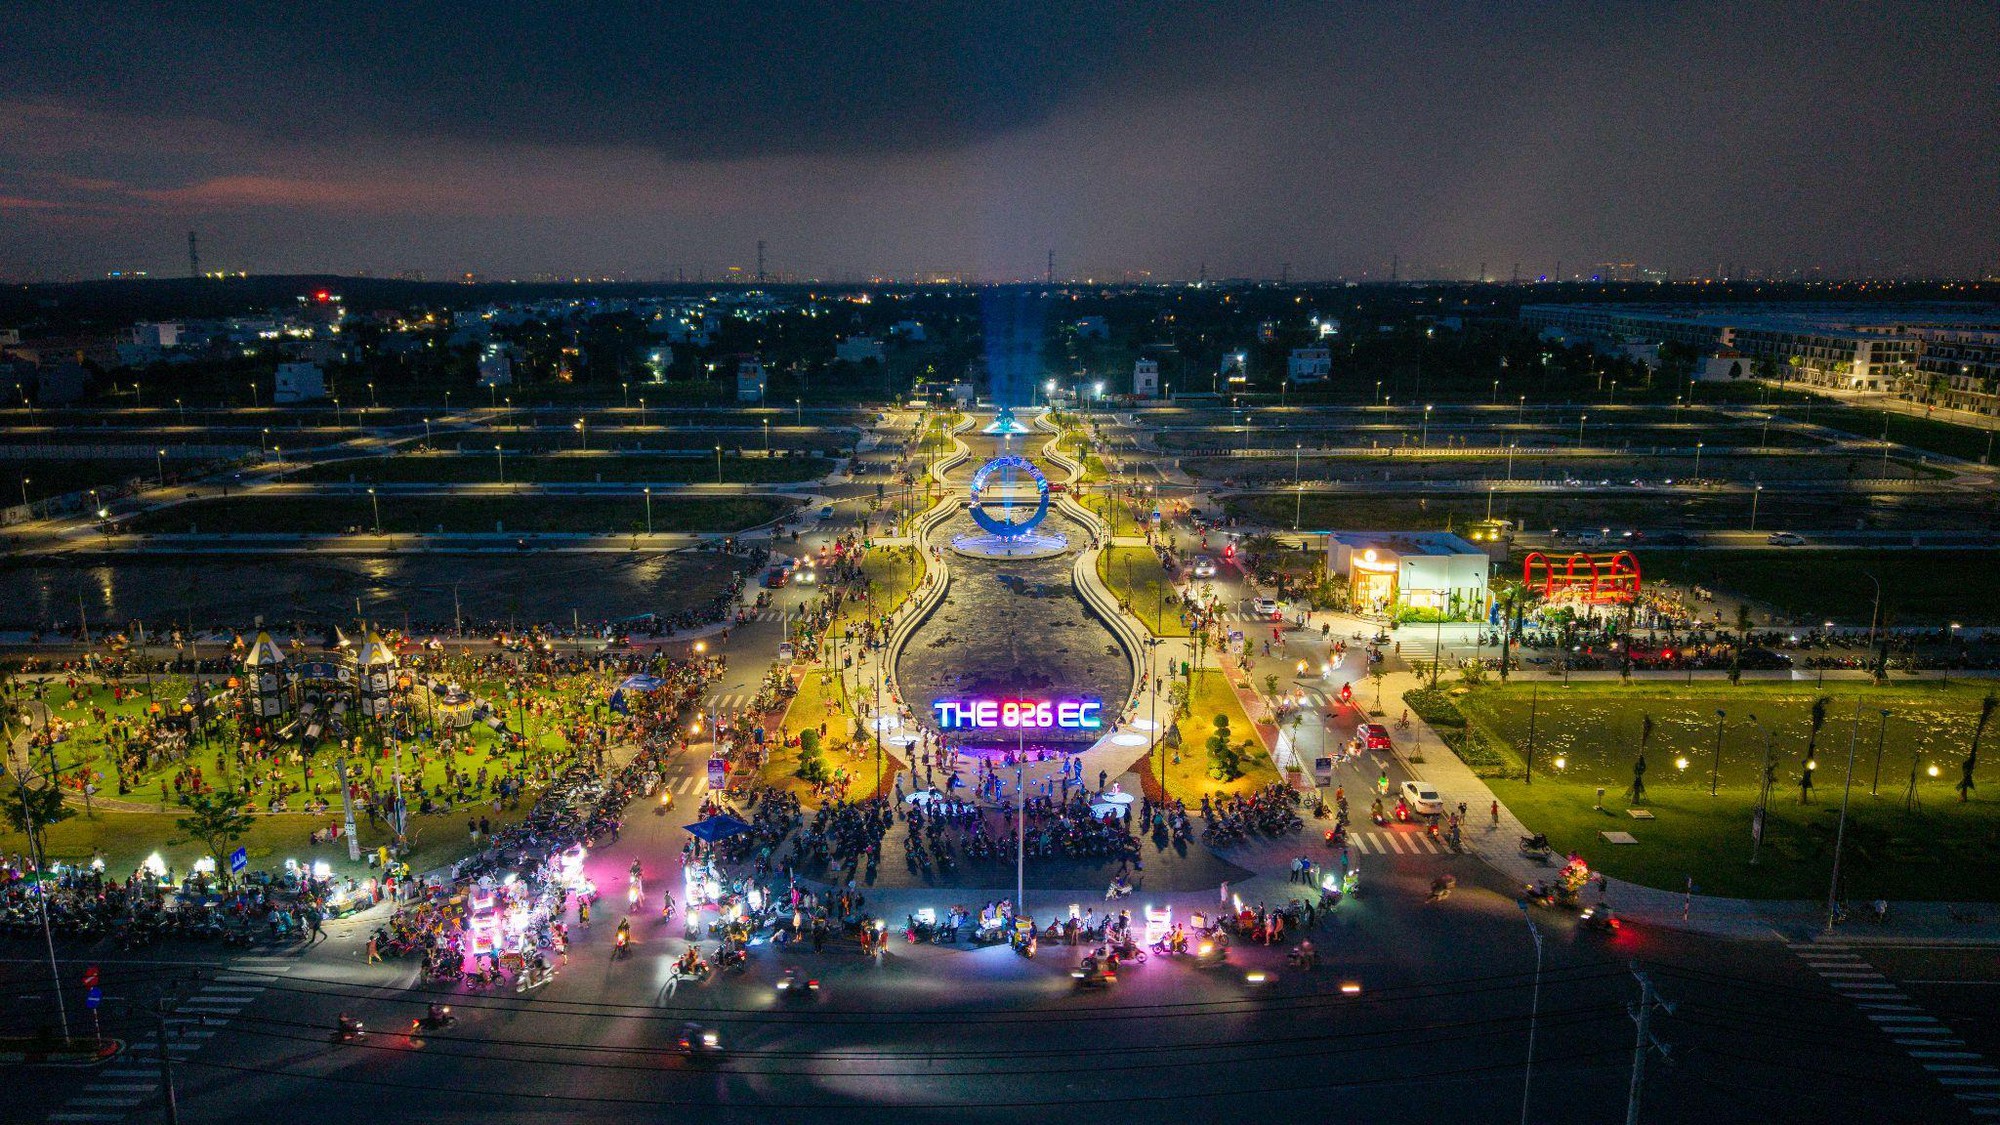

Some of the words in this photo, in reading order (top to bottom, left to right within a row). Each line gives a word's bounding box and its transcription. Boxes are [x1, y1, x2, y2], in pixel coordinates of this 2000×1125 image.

[934, 702, 998, 728] THE
[1002, 702, 1053, 728] 826
[1058, 702, 1101, 728] EC
